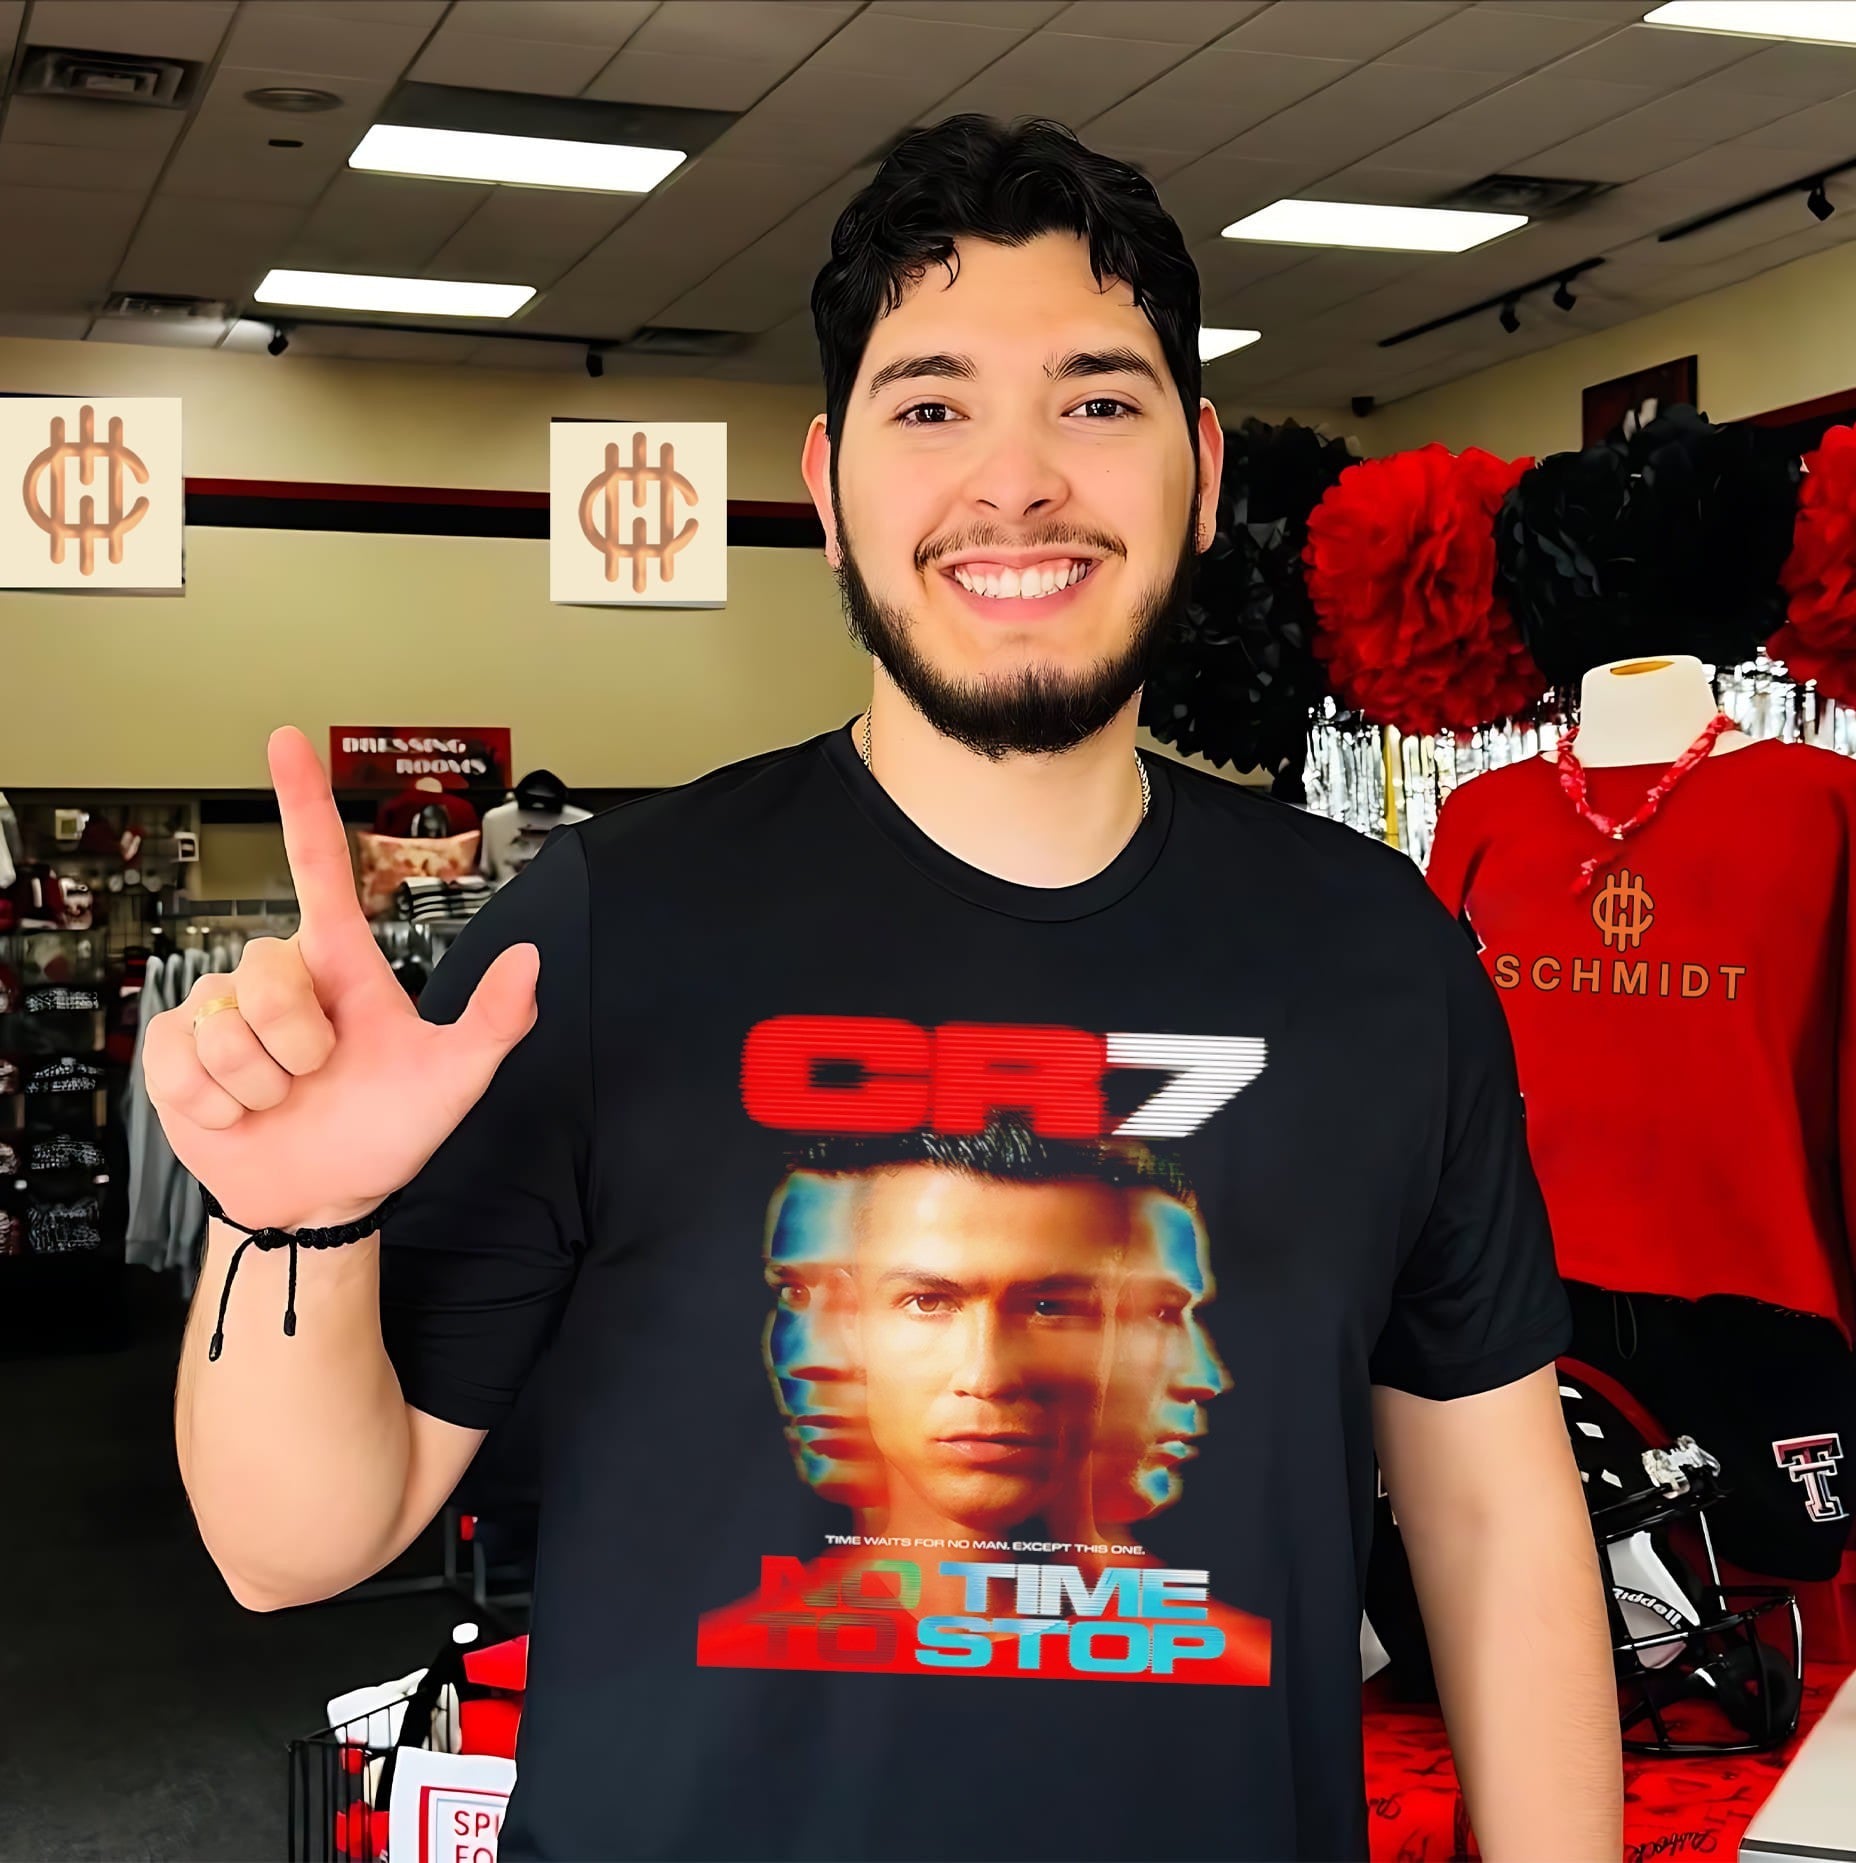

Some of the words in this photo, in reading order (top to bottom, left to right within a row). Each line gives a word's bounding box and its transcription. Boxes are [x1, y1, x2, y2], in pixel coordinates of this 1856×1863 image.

[342, 737, 467, 754] DRESSING
[396, 758, 488, 775] ROOMS
[1493, 953, 1747, 1001] SCHMIDT
[740, 1013, 1268, 1138] CR7
[824, 1534, 862, 1546] TIME
[863, 1536, 912, 1548] WAITS
[914, 1537, 945, 1549] FOR
[947, 1539, 970, 1550] NO
[972, 1540, 1011, 1551] MAN.
[1012, 1541, 1073, 1553] EXCEPT
[1074, 1543, 1109, 1554] THIS
[1111, 1545, 1146, 1556] ONE.
[760, 1555, 923, 1610] NO
[939, 1560, 1210, 1620] TIME
[748, 1611, 899, 1665] TO
[913, 1614, 1226, 1675] STOP
